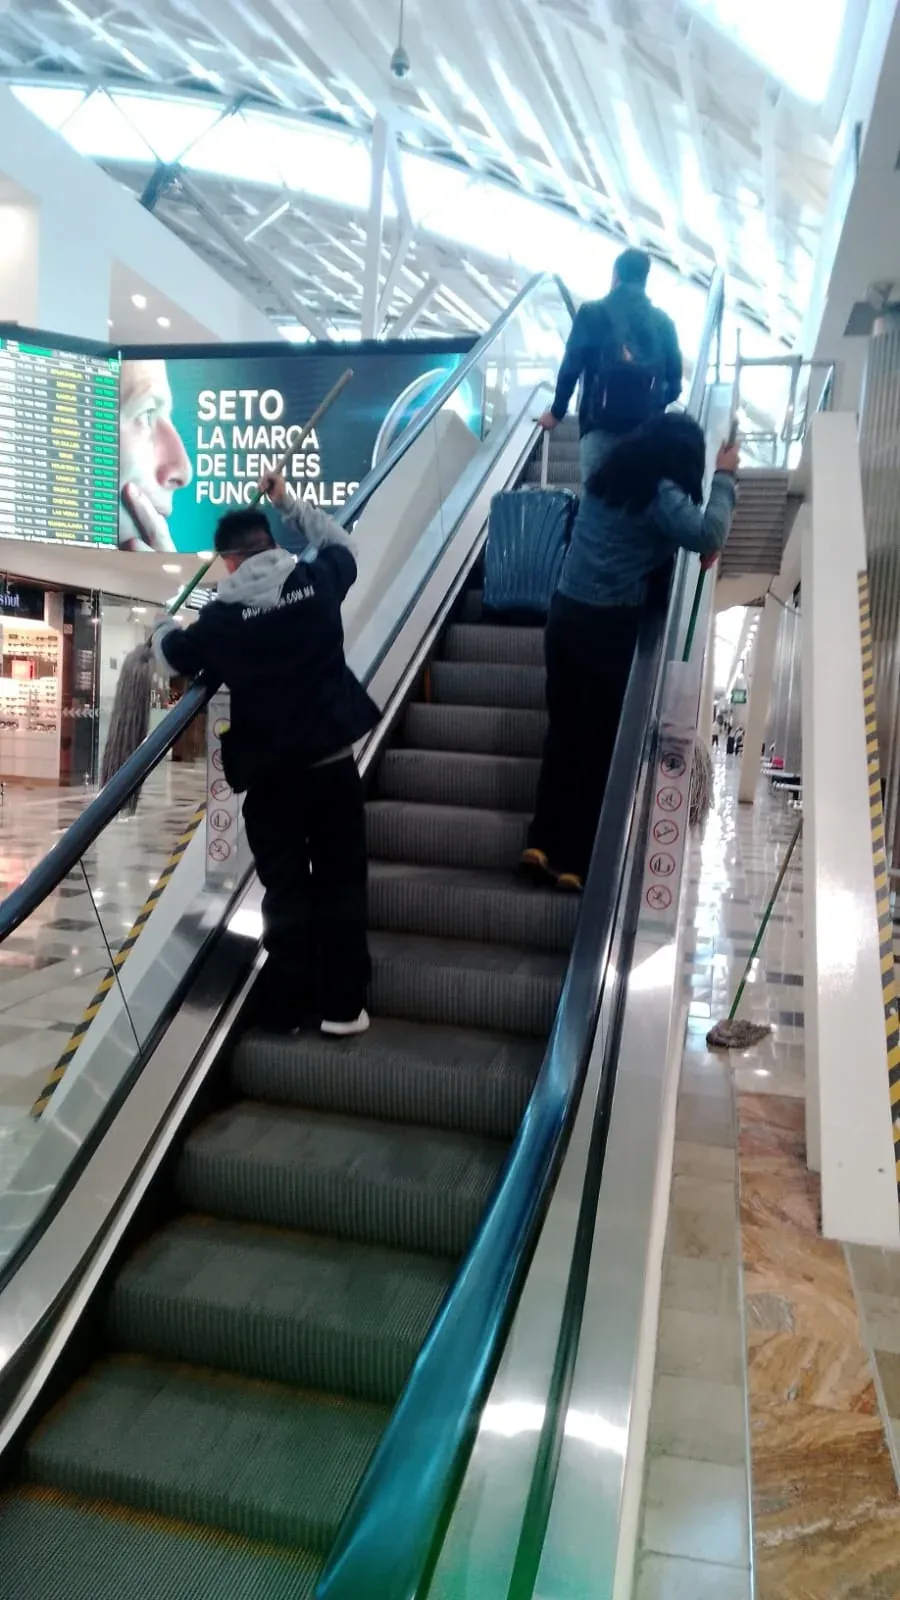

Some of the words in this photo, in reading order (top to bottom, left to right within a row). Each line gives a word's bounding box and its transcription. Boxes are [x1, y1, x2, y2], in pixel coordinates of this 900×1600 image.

[197, 389, 284, 421] SETO
[197, 425, 226, 450] LA
[232, 425, 320, 450] MARCA
[196, 453, 226, 477] DE
[195, 481, 360, 506] FUNCNALE
